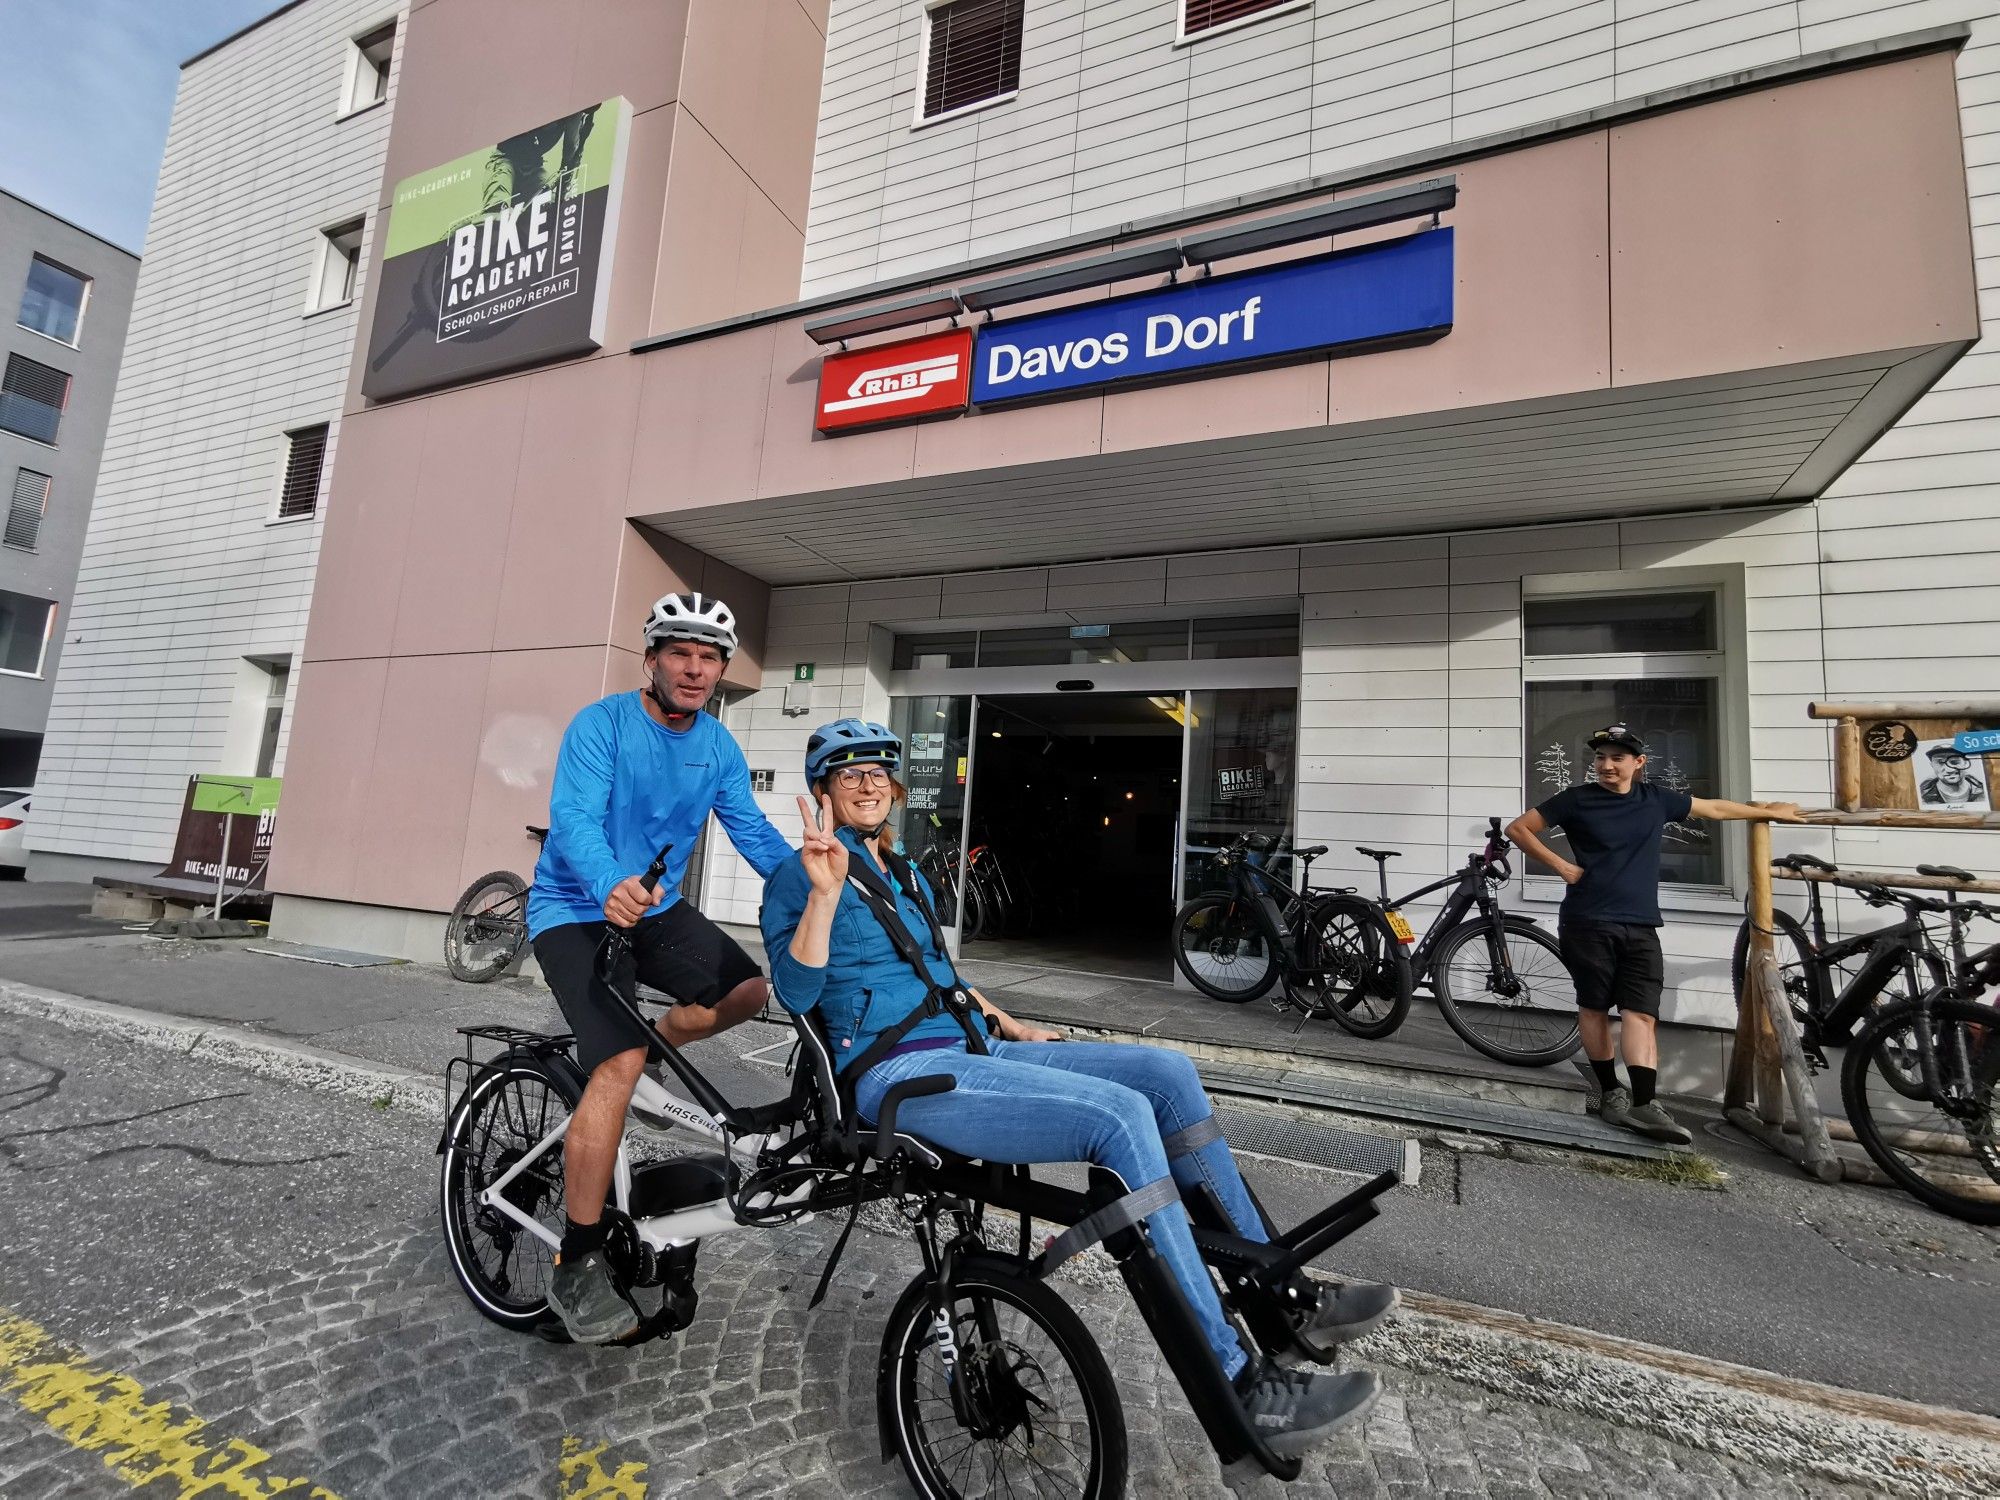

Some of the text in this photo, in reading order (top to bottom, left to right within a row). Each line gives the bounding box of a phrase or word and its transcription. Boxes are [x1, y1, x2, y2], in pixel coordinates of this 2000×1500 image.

[400, 169, 472, 203] BIKE-ACADEMY.CH
[451, 190, 554, 280] BIKE
[559, 204, 577, 264] DAVOS
[447, 248, 548, 307] ACADEMY
[444, 279, 570, 333] SCHOOL/SHOP/REPAIR
[988, 296, 1261, 386] Davos Dorf
[865, 371, 919, 396] RhB
[800, 665, 807, 679] 8
[1963, 736, 1980, 749] So
[1221, 769, 1254, 785] BIKE
[907, 787, 941, 796] LANGLAUF
[907, 794, 932, 802] SCHULE
[906, 801, 938, 810] DAVOS.CH
[663, 1102, 699, 1124] HASE
